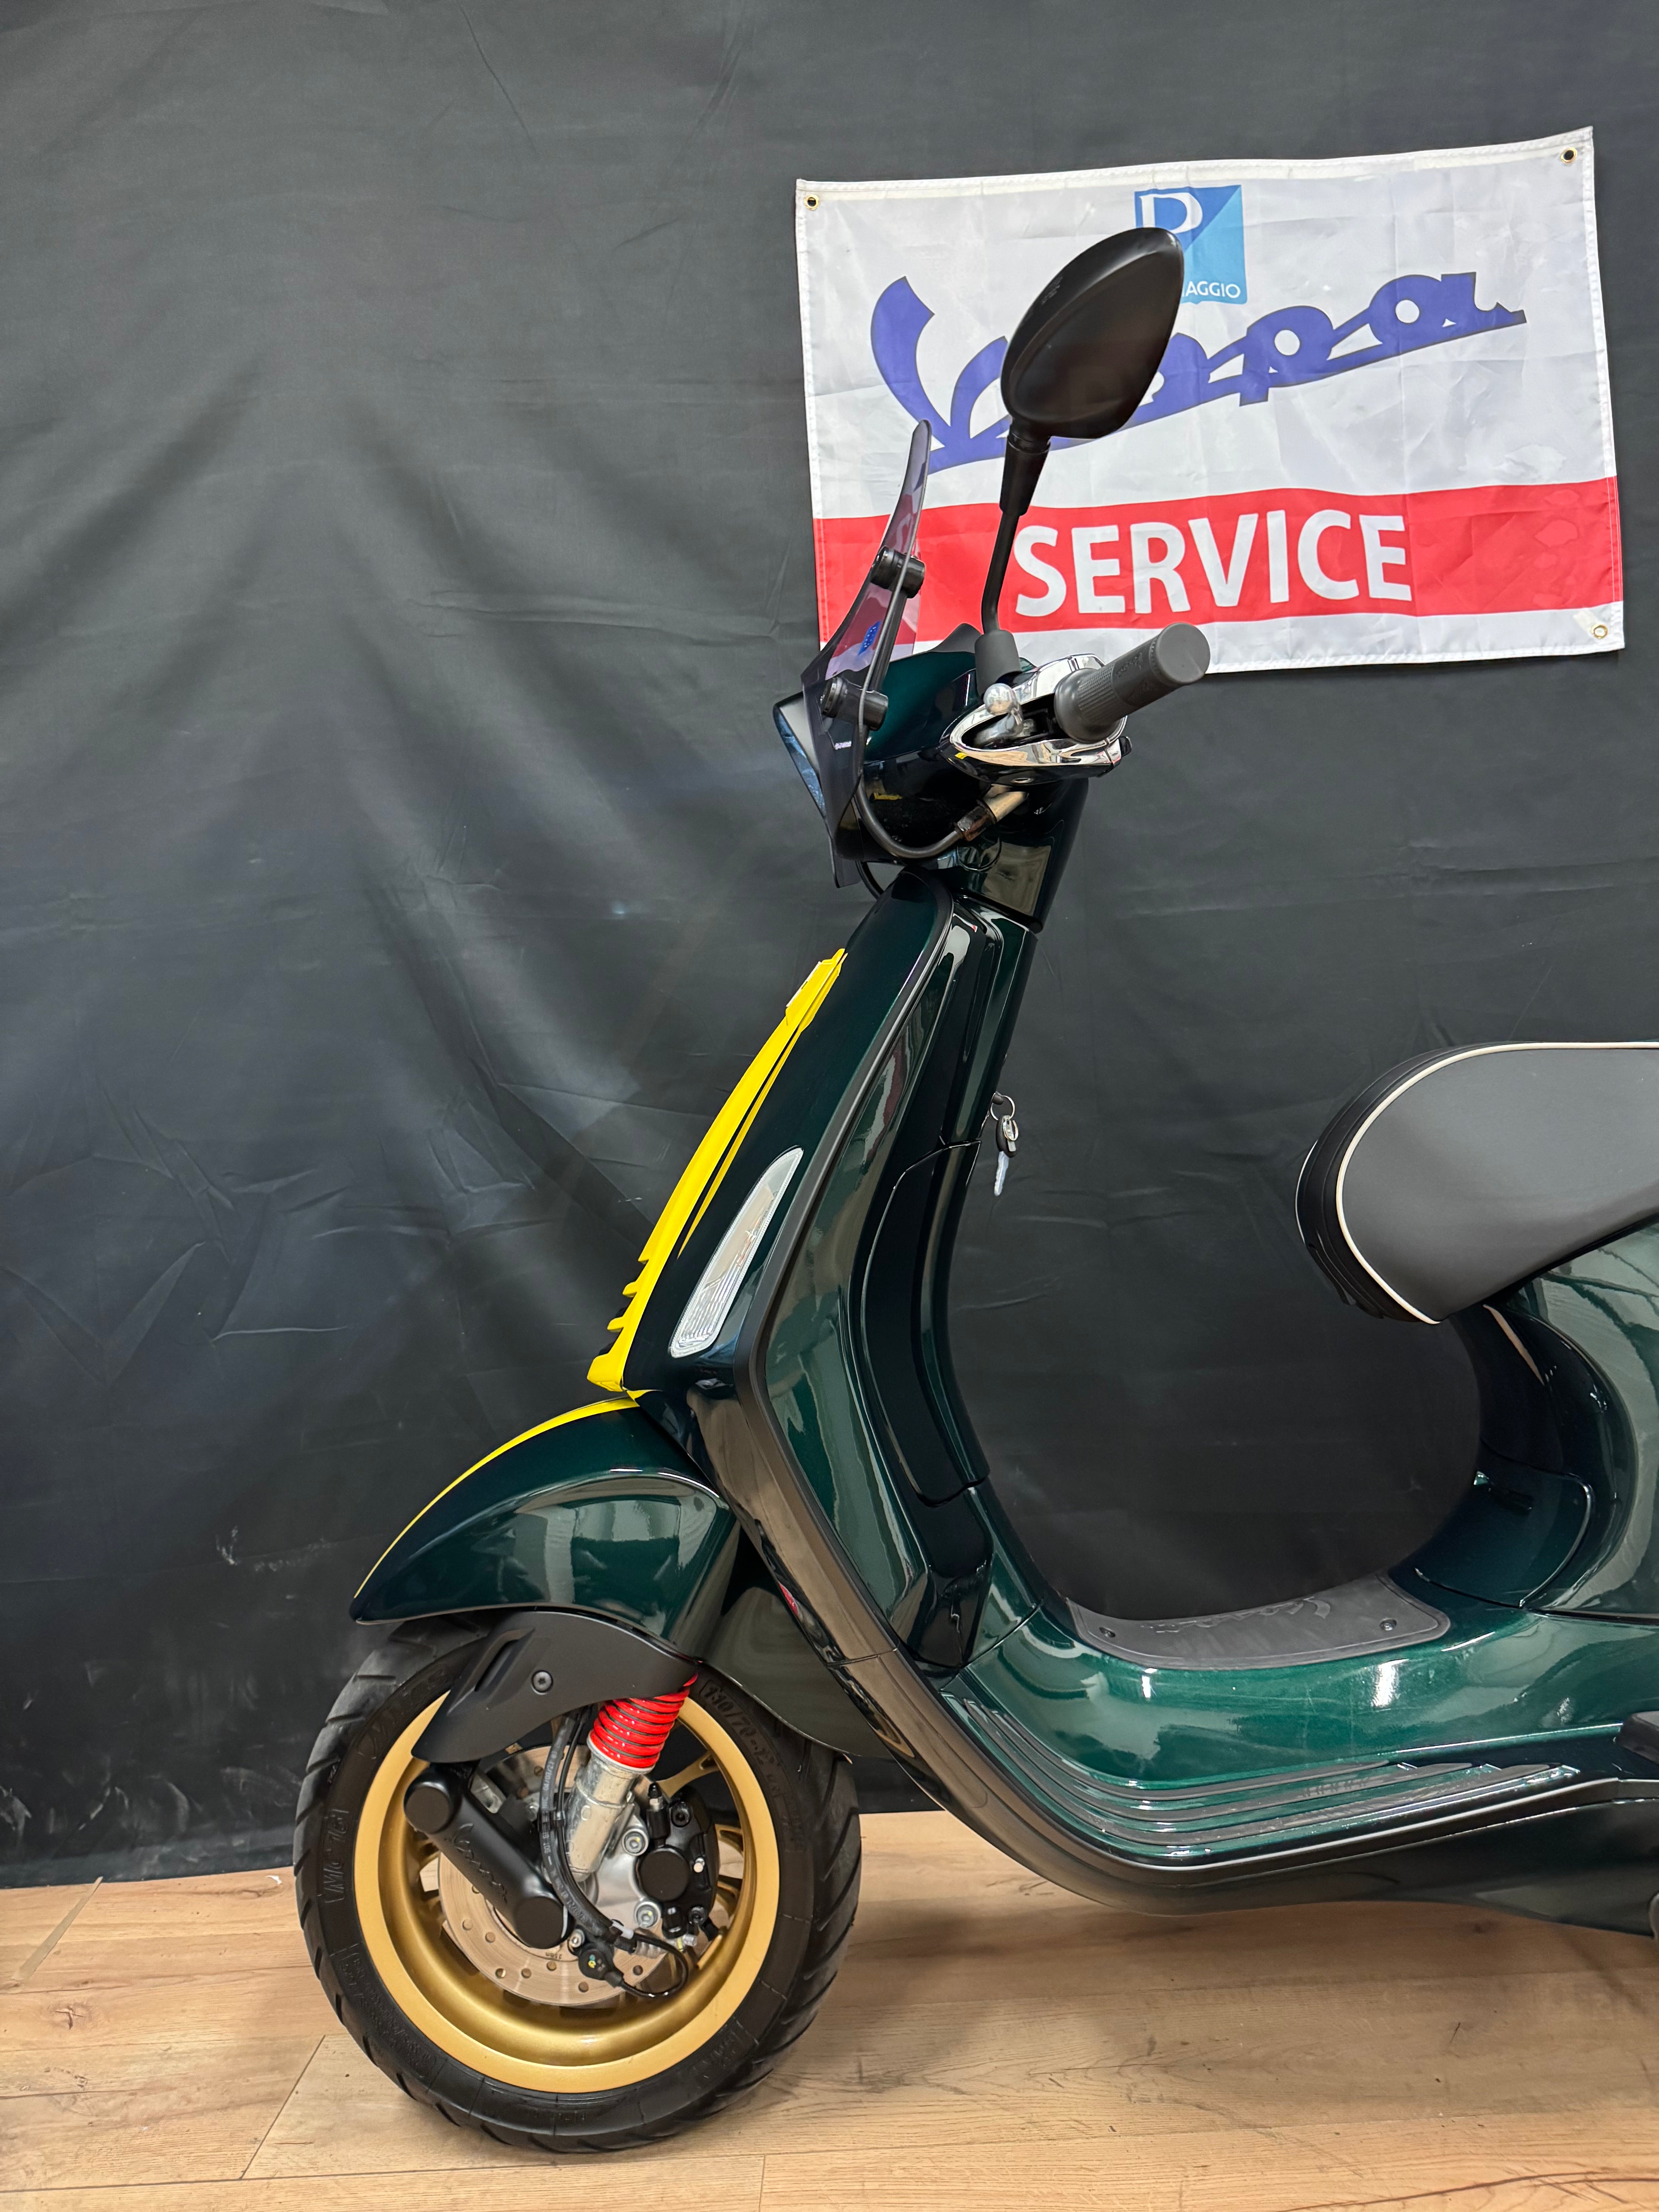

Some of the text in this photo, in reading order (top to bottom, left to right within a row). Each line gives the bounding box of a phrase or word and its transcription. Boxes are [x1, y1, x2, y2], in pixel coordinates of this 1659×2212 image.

[1139, 192, 1203, 234] P
[1181, 280, 1241, 299] AGGIO
[1013, 509, 1412, 617] SERVICE
